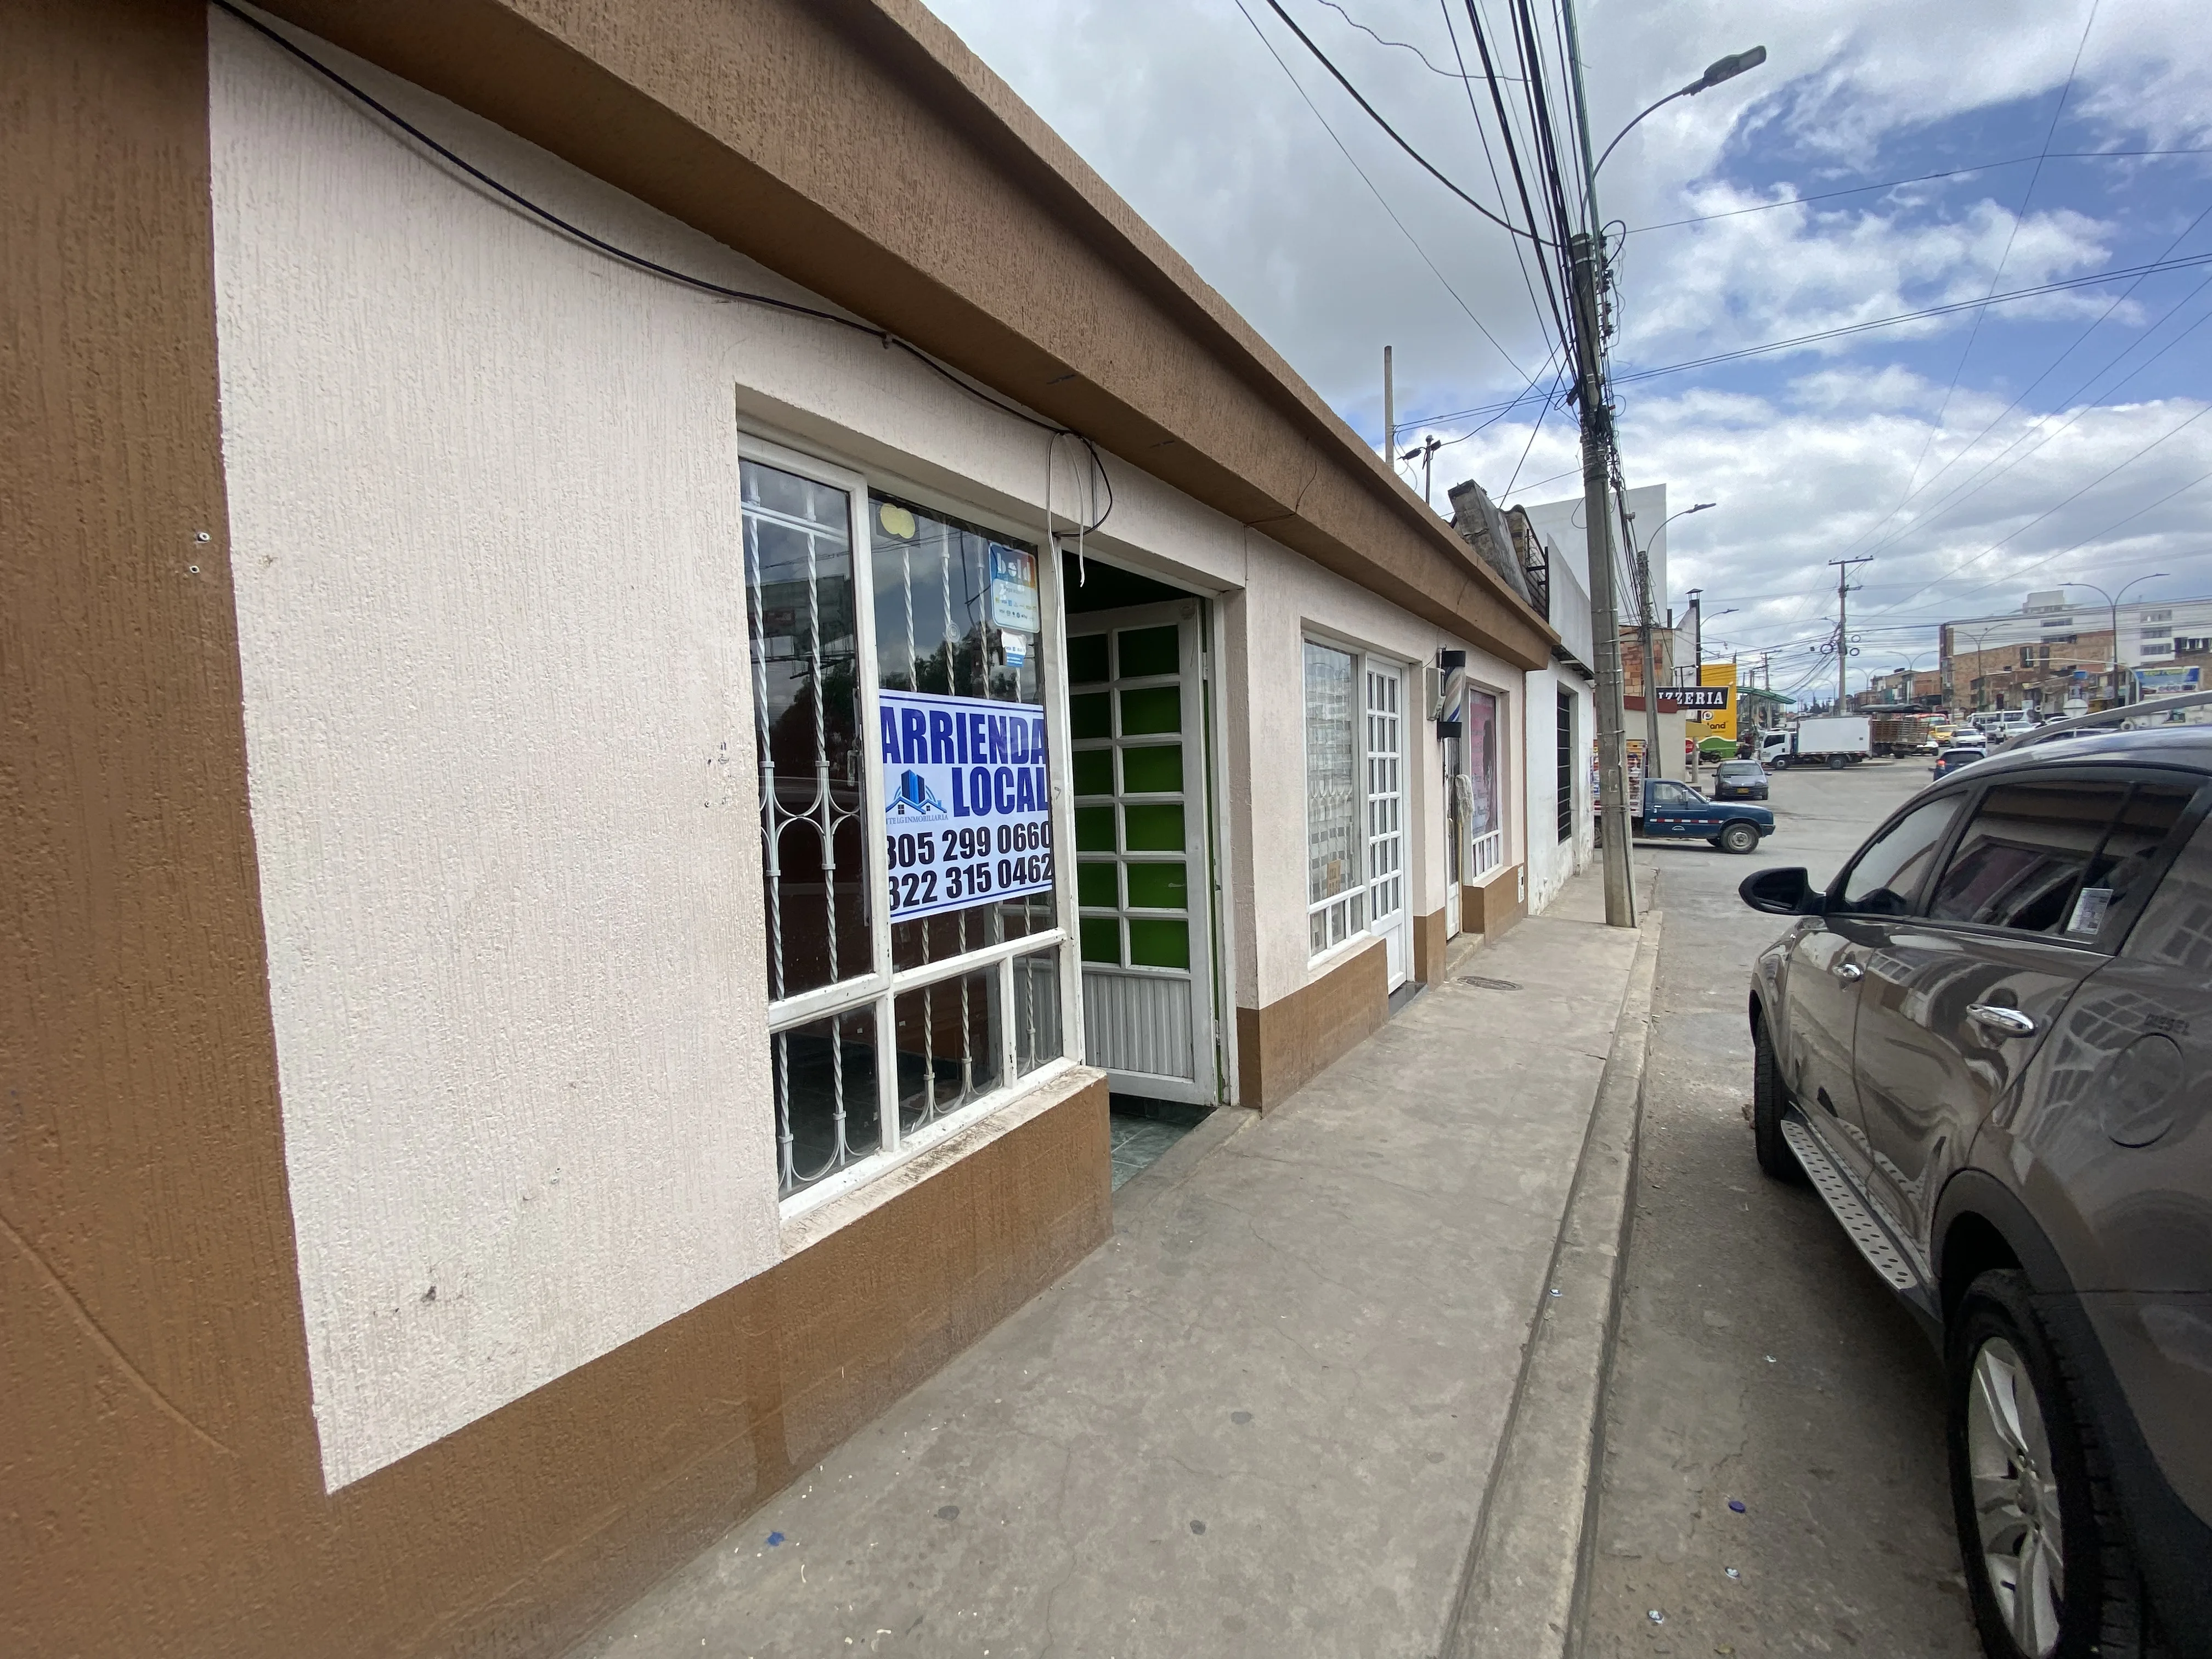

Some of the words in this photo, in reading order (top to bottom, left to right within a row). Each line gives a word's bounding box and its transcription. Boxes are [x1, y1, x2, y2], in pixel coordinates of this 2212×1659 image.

[997, 553, 1031, 583] bold
[880, 707, 1046, 764] ARRIENDA
[952, 766, 1048, 817] LOCAL
[942, 827, 991, 861] 299
[997, 821, 1050, 854] 0660
[889, 870, 938, 911] 322
[945, 862, 991, 900] 315
[997, 853, 1052, 888] 0462
